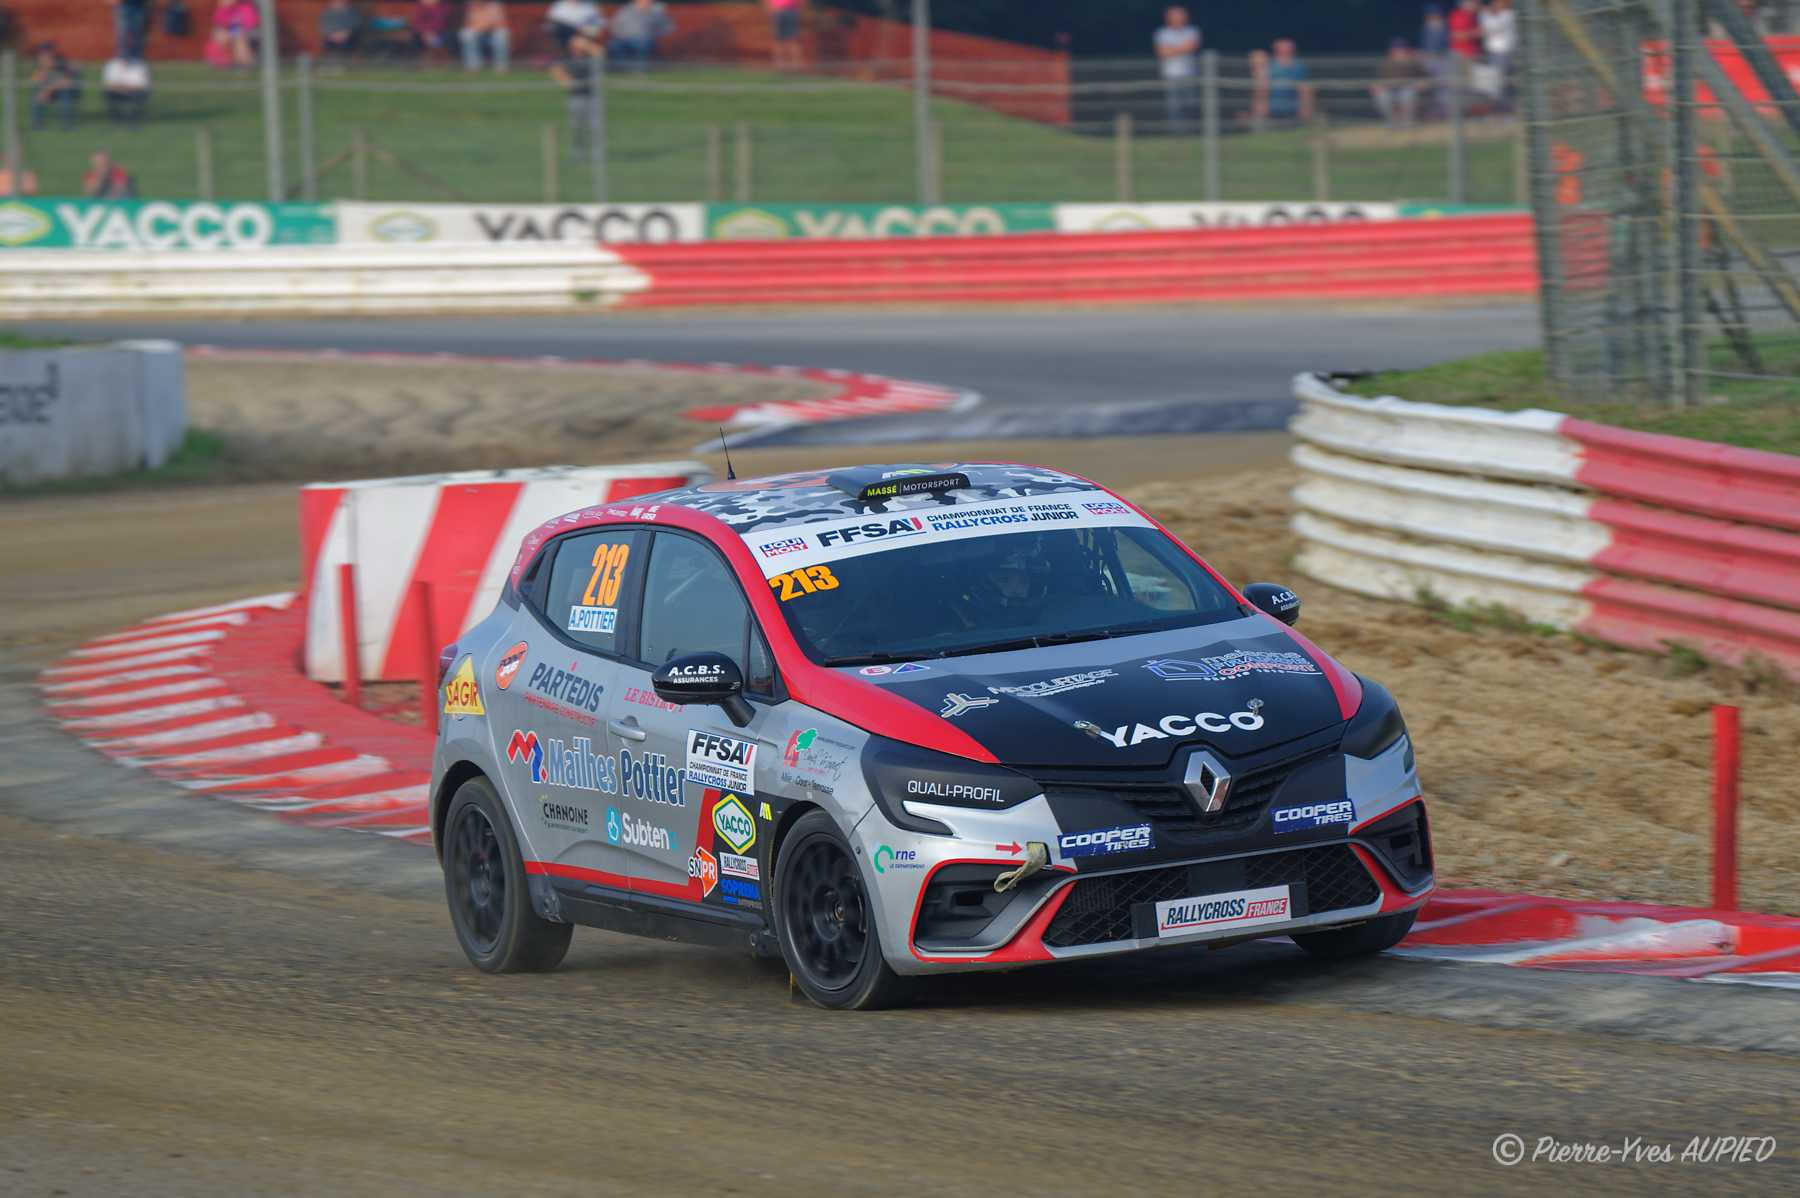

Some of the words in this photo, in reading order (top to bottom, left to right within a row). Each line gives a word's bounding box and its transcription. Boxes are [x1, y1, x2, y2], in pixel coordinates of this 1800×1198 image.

[56, 202, 272, 248] YACCO
[474, 207, 680, 241] YACCO
[903, 478, 960, 492] MOTORSPORT
[927, 505, 1001, 522] CHAMPIONNAT
[1003, 504, 1017, 513] DE
[1018, 502, 1071, 512] FRANCE
[931, 514, 1028, 532] RALLYCROSS
[1030, 510, 1080, 522] JUNIOR
[817, 517, 918, 548] FFSA
[759, 537, 805, 552] LIQUI
[764, 544, 809, 557] MOLY
[582, 543, 630, 607] 213
[767, 565, 840, 602] 213
[668, 664, 726, 678] A.C.B.S.
[673, 676, 719, 685] ASSURANCES
[528, 662, 604, 713] PARTEDIS
[1099, 711, 1264, 748] YACCO
[691, 732, 751, 766] FFSA
[549, 736, 617, 795] Mailhes
[620, 748, 687, 807] Pottier
[688, 770, 727, 788] RALLYCROSS
[728, 779, 747, 792] JUNIOR
[689, 761, 722, 777] CHAMPIONNAT
[722, 769, 730, 777] DE
[730, 770, 748, 782] FRANCE
[907, 780, 1005, 802] QUALI-PROFIL
[543, 803, 588, 825] CHANOINE
[1274, 801, 1352, 822] COOPER
[1313, 812, 1353, 825] TIRES
[622, 812, 670, 850] Subten
[718, 812, 751, 837] YACCO
[1060, 826, 1151, 849] COOPER
[1105, 837, 1150, 851] TIRES
[1166, 898, 1246, 926] RALLYCROSS
[1247, 899, 1287, 917] FRANCE
